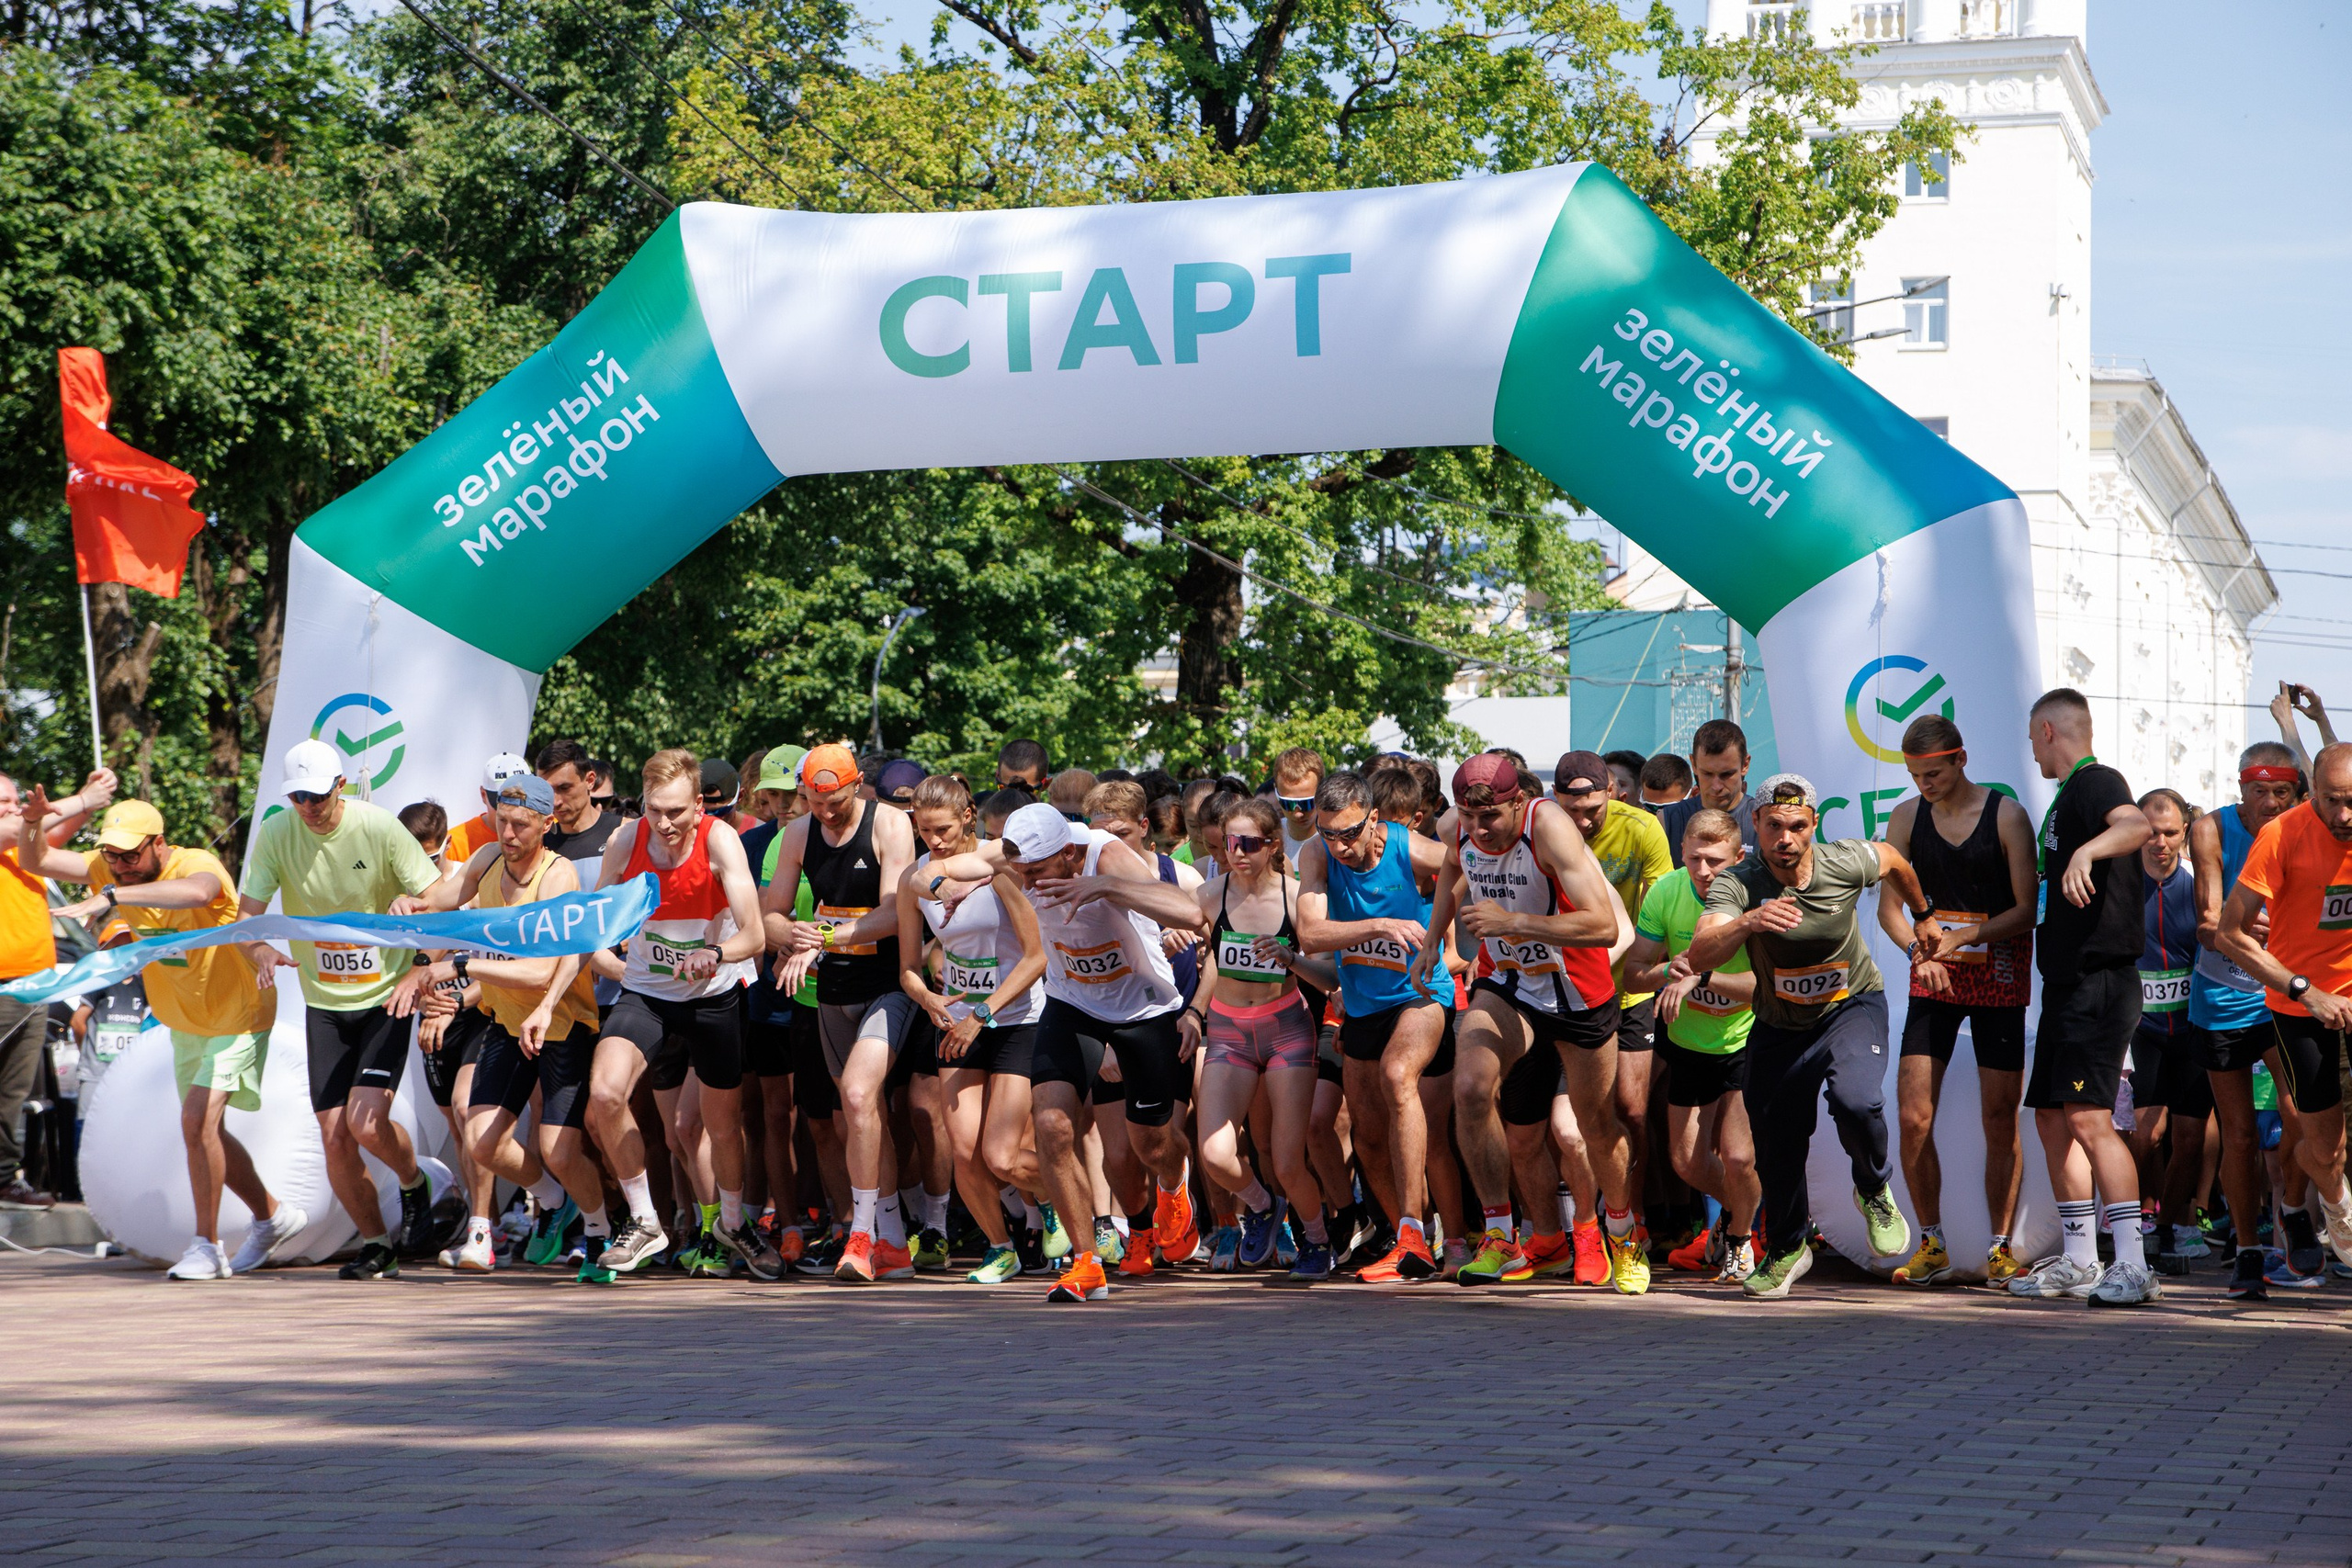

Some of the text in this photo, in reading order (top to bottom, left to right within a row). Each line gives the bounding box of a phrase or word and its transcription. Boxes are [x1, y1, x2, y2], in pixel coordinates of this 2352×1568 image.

[879, 253, 1352, 378] СТАРТ
[1613, 308, 1833, 479] зелёный
[433, 350, 630, 528] зелёный
[1579, 345, 1790, 520] марафон
[458, 393, 661, 568] марафон
[1468, 870, 1528, 886] Sporting Club
[1481, 886, 1516, 899] Noale
[2328, 897, 2352, 918] 00
[322, 952, 373, 971] 0056
[652, 944, 695, 965] 055
[1066, 952, 1122, 974] 0032
[951, 965, 994, 989] 0544
[1783, 972, 1842, 994] 0092
[2143, 980, 2190, 999] 0378
